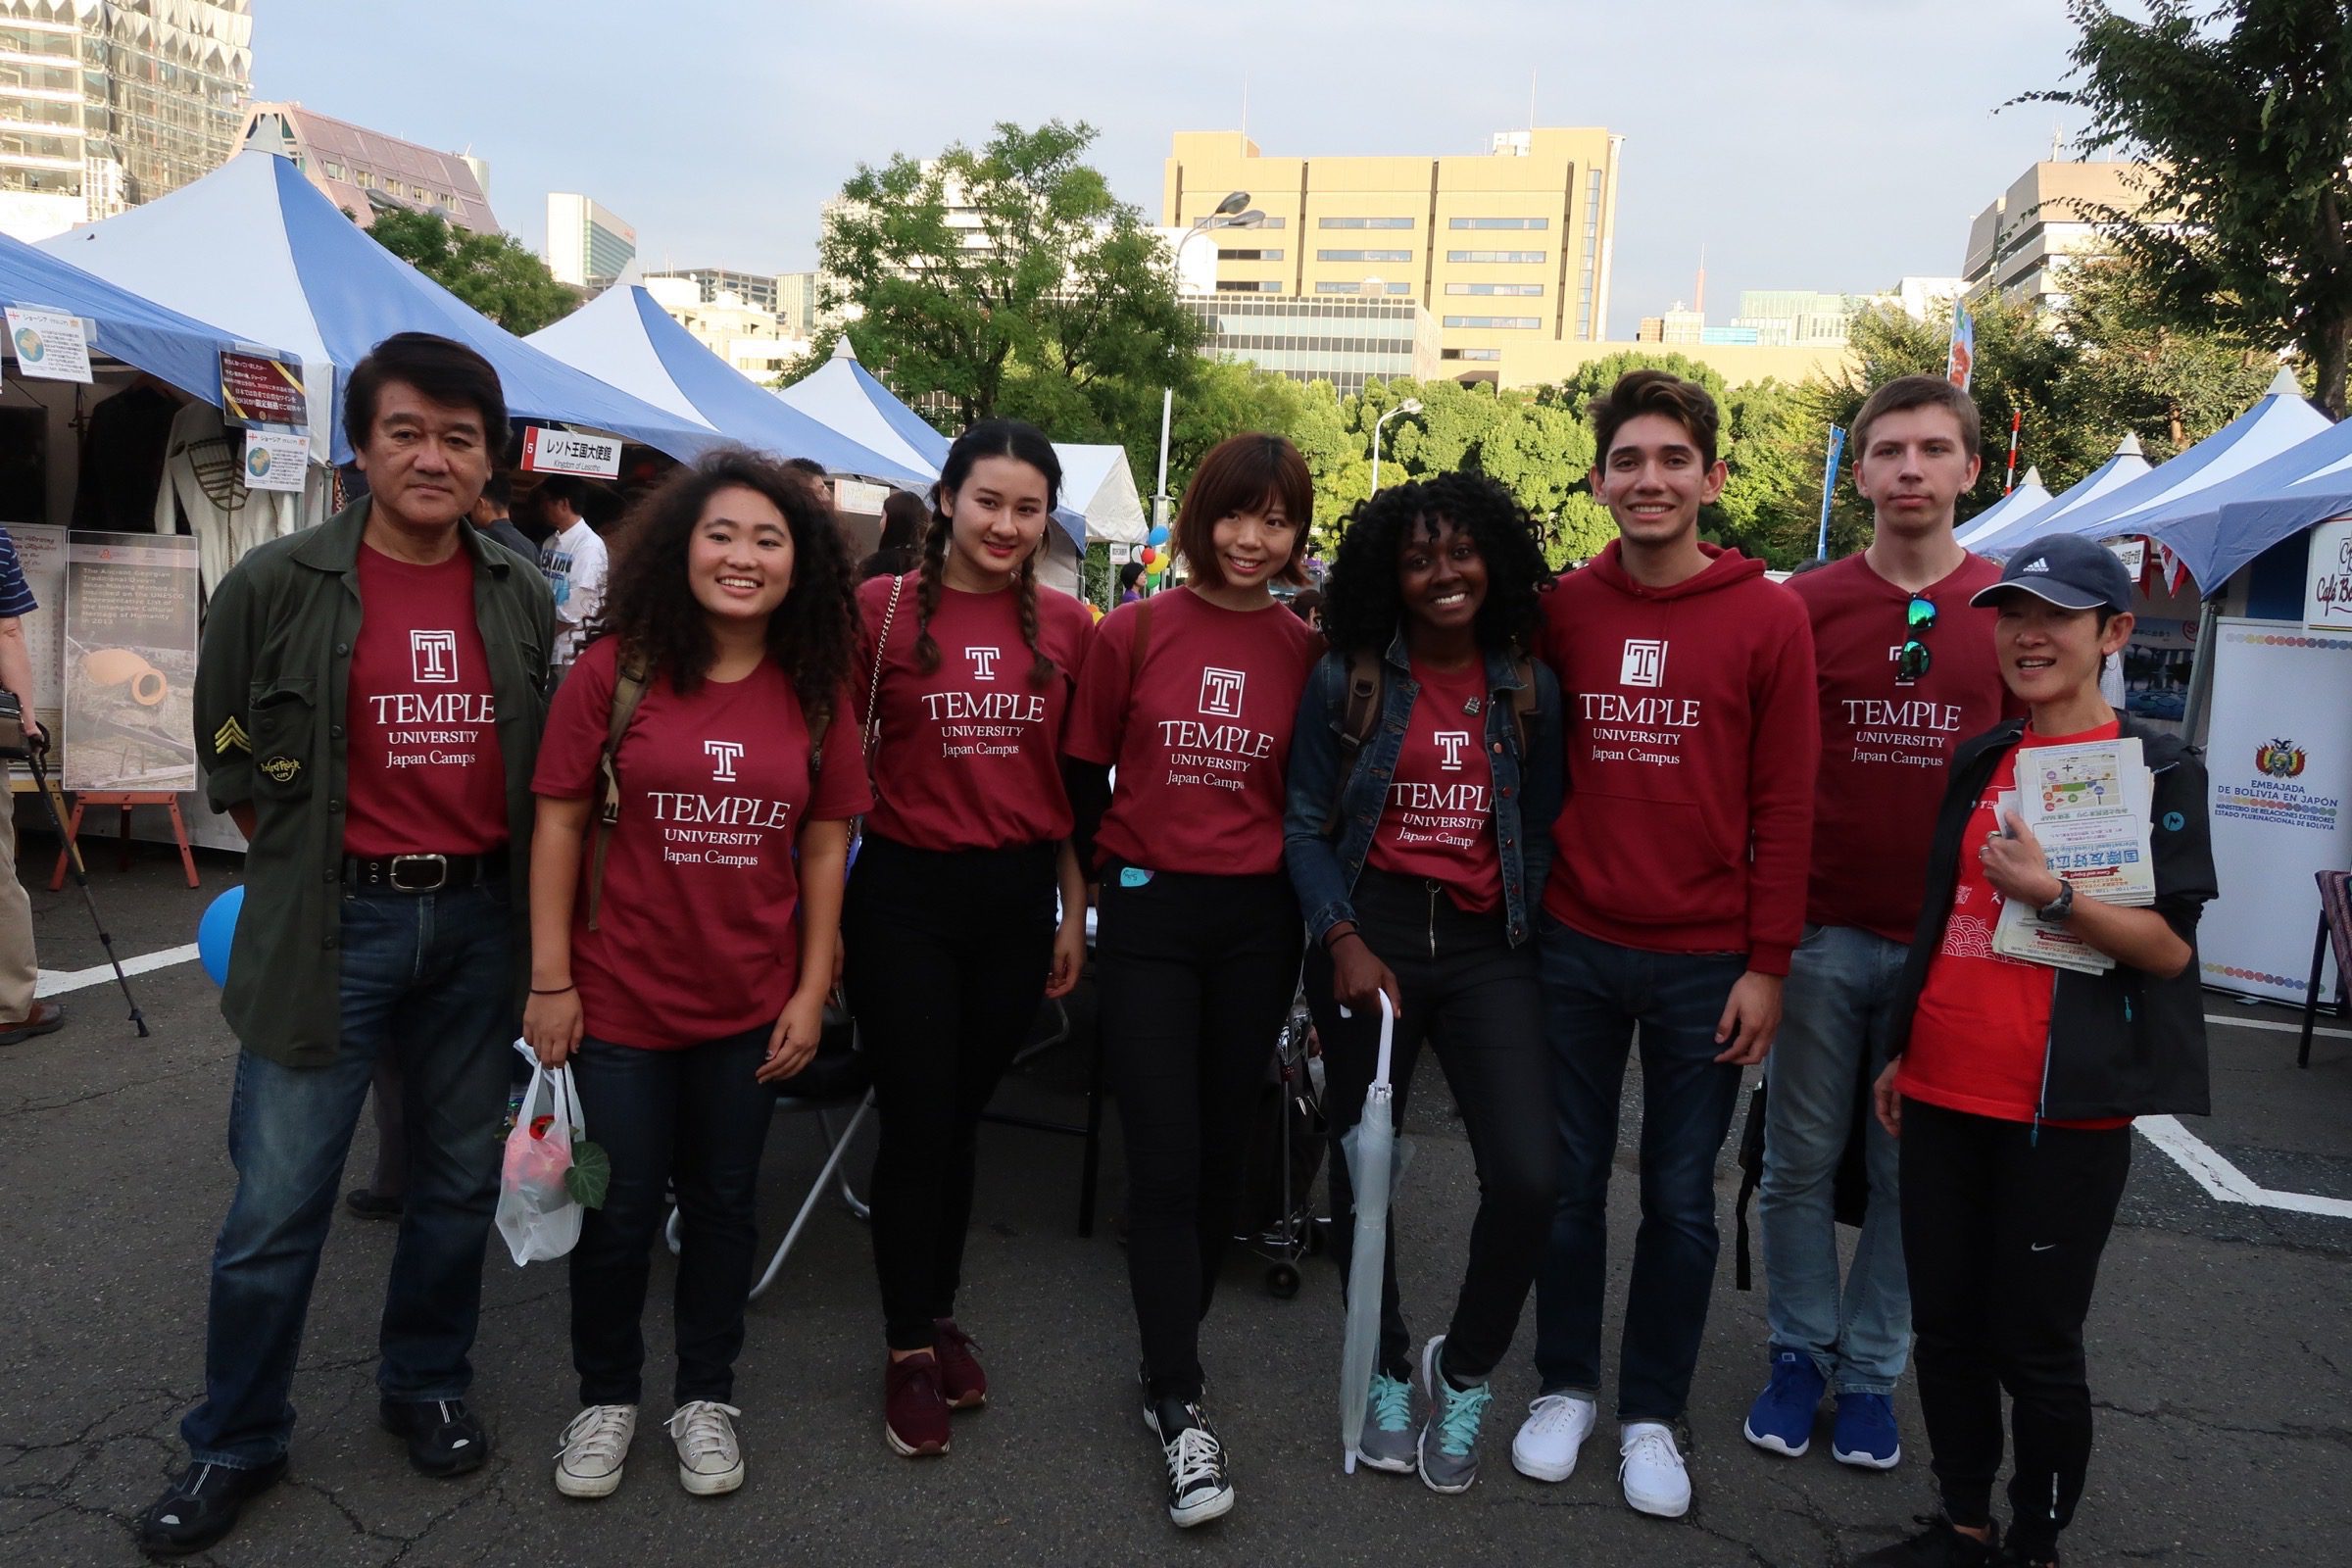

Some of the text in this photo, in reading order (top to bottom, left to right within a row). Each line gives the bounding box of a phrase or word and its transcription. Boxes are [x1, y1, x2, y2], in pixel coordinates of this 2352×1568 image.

[527, 443, 534, 454] 5
[547, 439, 612, 462] レソト王国大使館
[554, 459, 574, 470] Kingdom
[581, 463, 601, 471] Lesotho
[369, 693, 496, 724] TEMPLE
[921, 692, 1046, 723] TEMPLE
[1579, 693, 1700, 727] TEMPLE
[1841, 700, 1961, 732] TEMPLE
[388, 730, 478, 745] UNIVERSITY
[941, 725, 1024, 738] UNIVERSITY
[1157, 720, 1274, 759] TEMPLE
[1592, 728, 1681, 746] UNIVERSITY
[1855, 731, 1944, 749] UNIVERSITY
[386, 751, 426, 768] Japan
[943, 742, 1020, 759] Japan Campus
[1592, 745, 1681, 766] Japan Campus
[1851, 747, 1943, 768] Japan Campus
[1171, 754, 1251, 772] UNIVERSITY
[1166, 770, 1200, 786] Japan
[2251, 780, 2305, 794] EMBAJADA
[2234, 788, 2278, 800] BOLIVIA
[2283, 793, 2297, 802] EN
[2301, 795, 2338, 808] JAPÓN
[647, 792, 791, 830] TEMPLE
[2215, 809, 2240, 818] ESTADO
[2241, 813, 2295, 825] PLURINACIONAL
[2306, 821, 2335, 831] BOLIVIA
[2216, 804, 2250, 812] MINISTERIO
[2260, 808, 2298, 818] RELACIONES
[2299, 813, 2335, 824] EXTERIORES
[1402, 812, 1485, 830] UNIVERSITY
[664, 828, 763, 846] UNIVERSITY
[1396, 827, 1432, 843] Japan
[663, 847, 759, 868] Japan Campus
